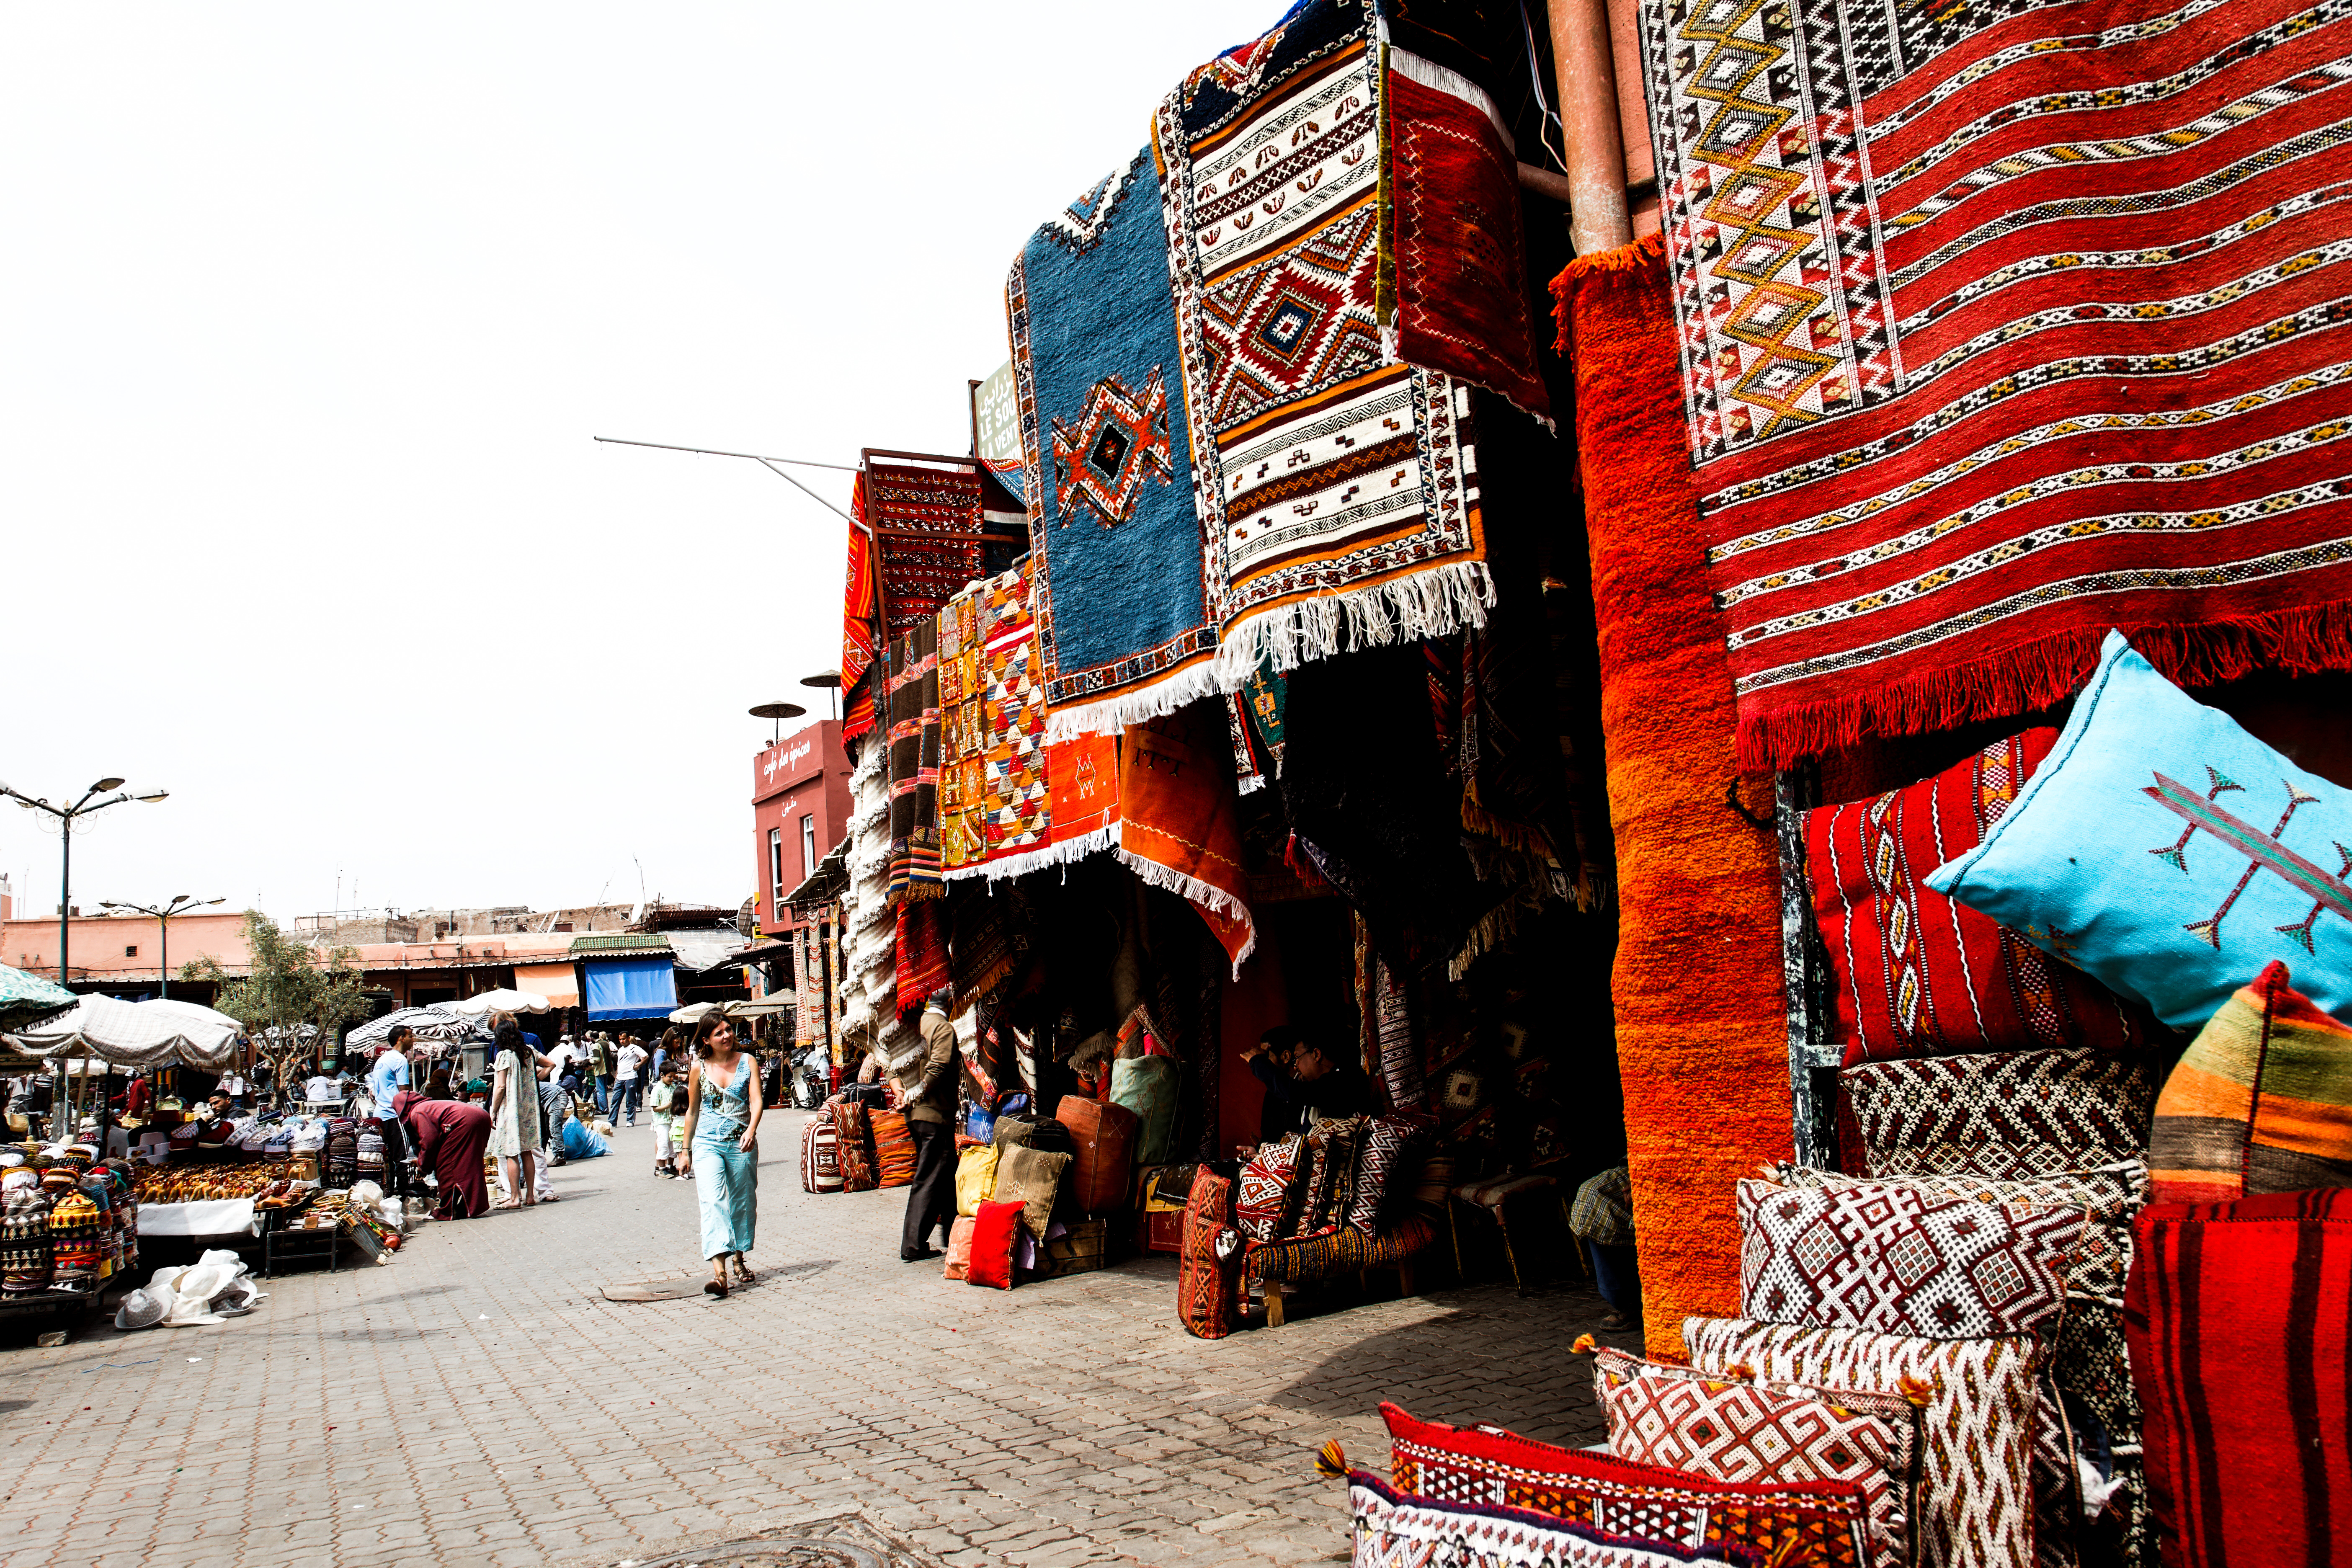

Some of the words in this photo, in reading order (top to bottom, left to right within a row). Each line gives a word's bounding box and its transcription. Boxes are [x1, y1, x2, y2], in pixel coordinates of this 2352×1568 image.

[980, 415, 993, 442] LE
[764, 750, 777, 784] café
[779, 748, 789, 770] des
[789, 740, 810, 771] épices
